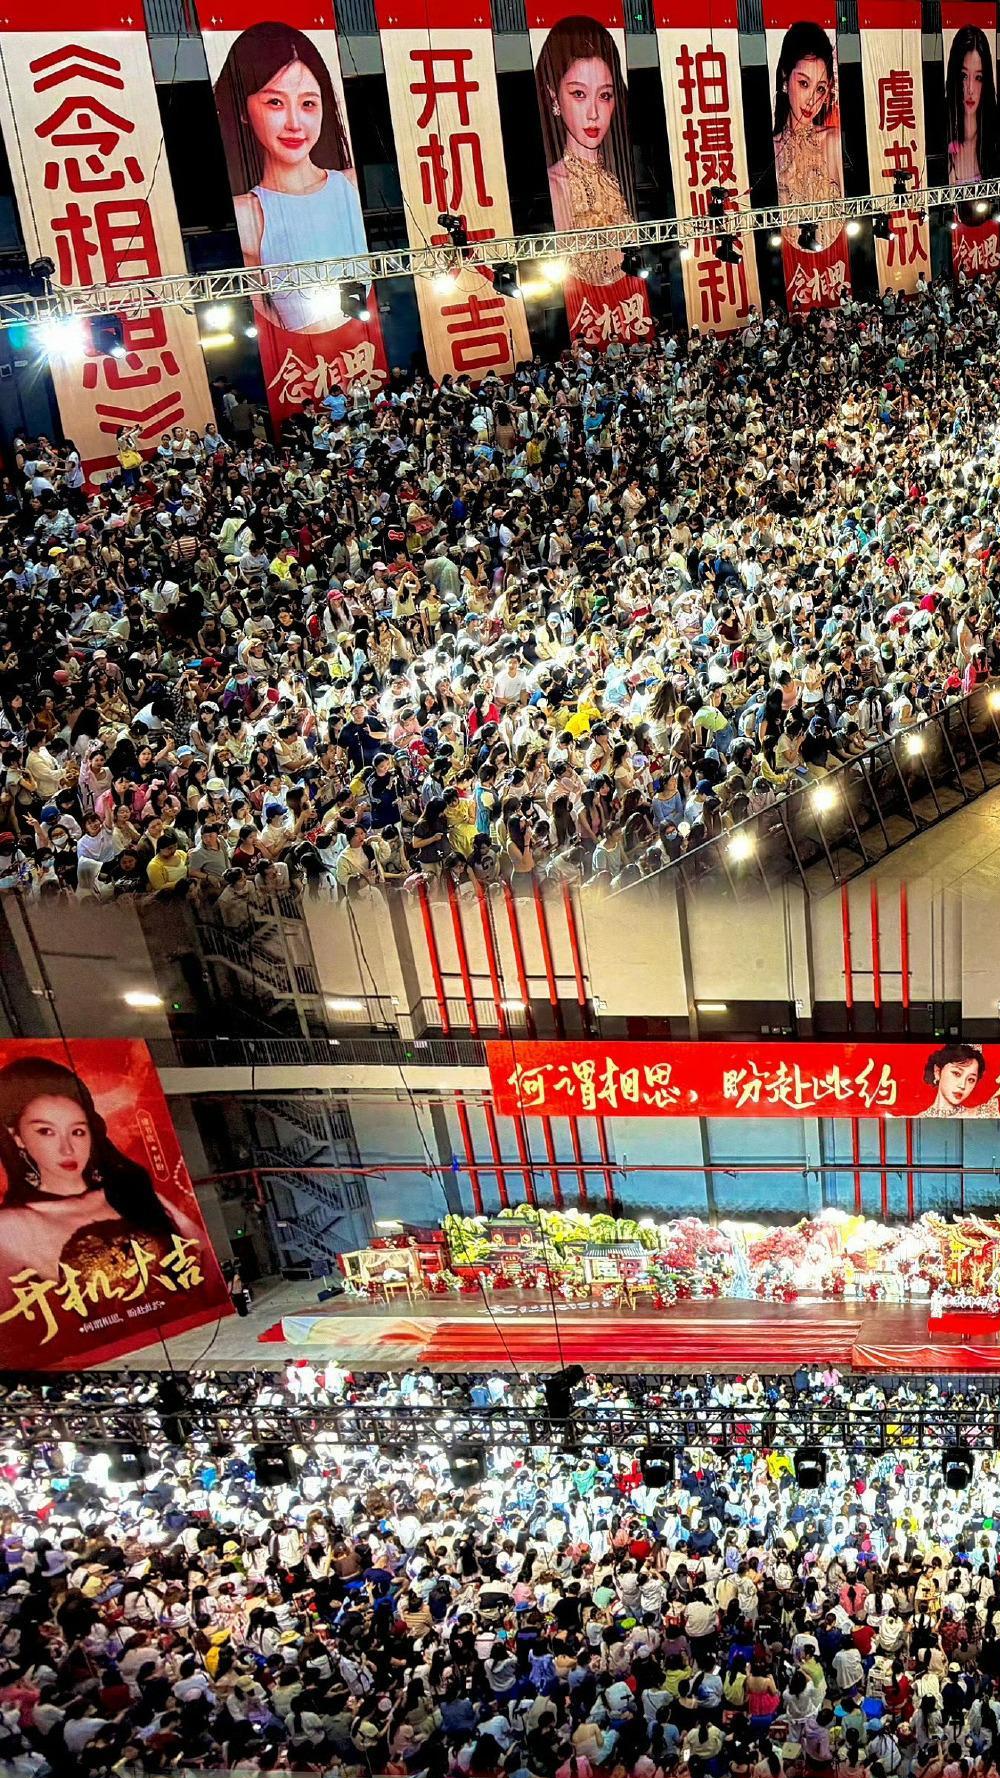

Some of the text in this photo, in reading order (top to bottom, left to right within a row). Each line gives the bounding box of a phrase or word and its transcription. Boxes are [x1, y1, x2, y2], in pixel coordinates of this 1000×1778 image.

[953, 233, 1000, 270] 念相思
[786, 260, 852, 304] 念相思
[570, 293, 652, 344] 念相思
[0, 1233, 204, 1345] 开机大吉
